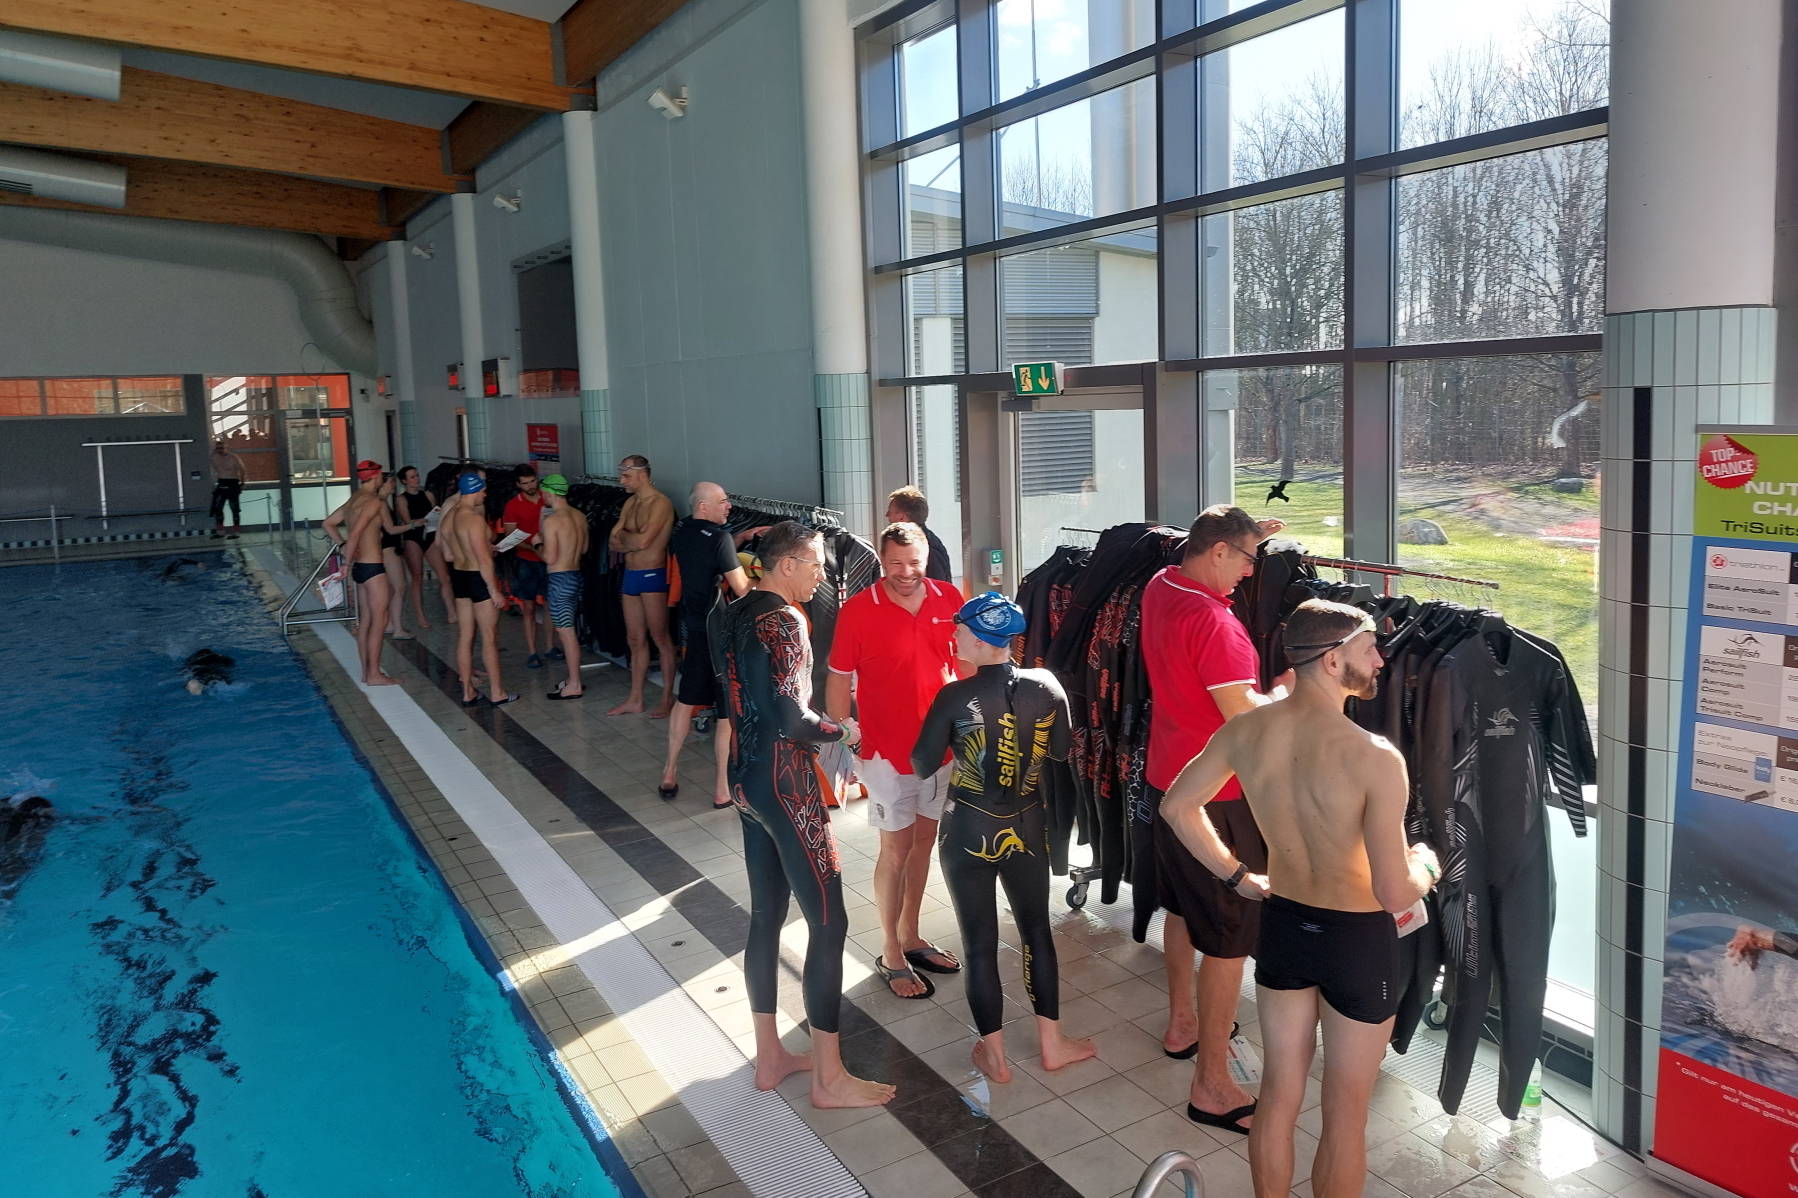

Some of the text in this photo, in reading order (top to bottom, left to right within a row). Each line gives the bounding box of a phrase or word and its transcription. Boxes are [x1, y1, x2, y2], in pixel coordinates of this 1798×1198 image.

[1702, 459, 1753, 478] CHANCE
[1744, 480, 1798, 496] NUT
[997, 712, 1024, 787] sailfish
[1696, 758, 1721, 769] Body
